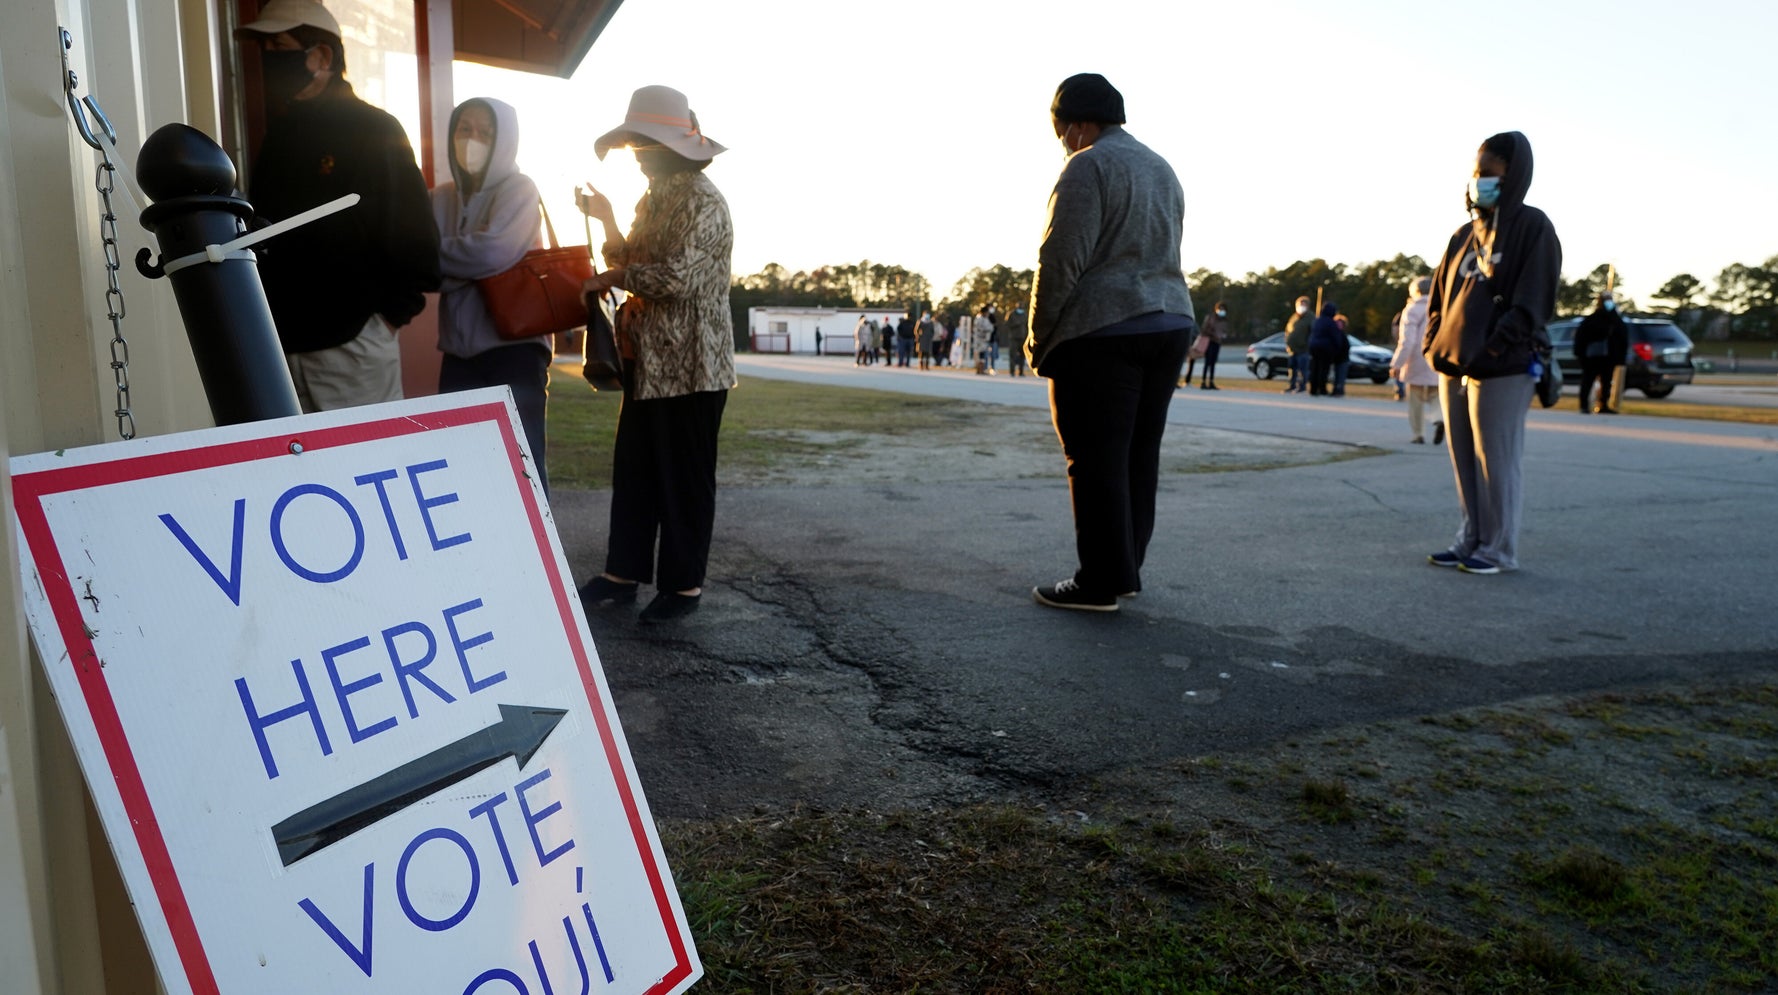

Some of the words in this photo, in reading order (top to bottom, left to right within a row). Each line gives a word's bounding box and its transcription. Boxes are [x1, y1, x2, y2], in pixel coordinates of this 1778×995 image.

[157, 459, 473, 608] VOTE
[234, 598, 508, 781] HERE
[297, 768, 577, 980] VOTE
[461, 866, 615, 995] UÍ
